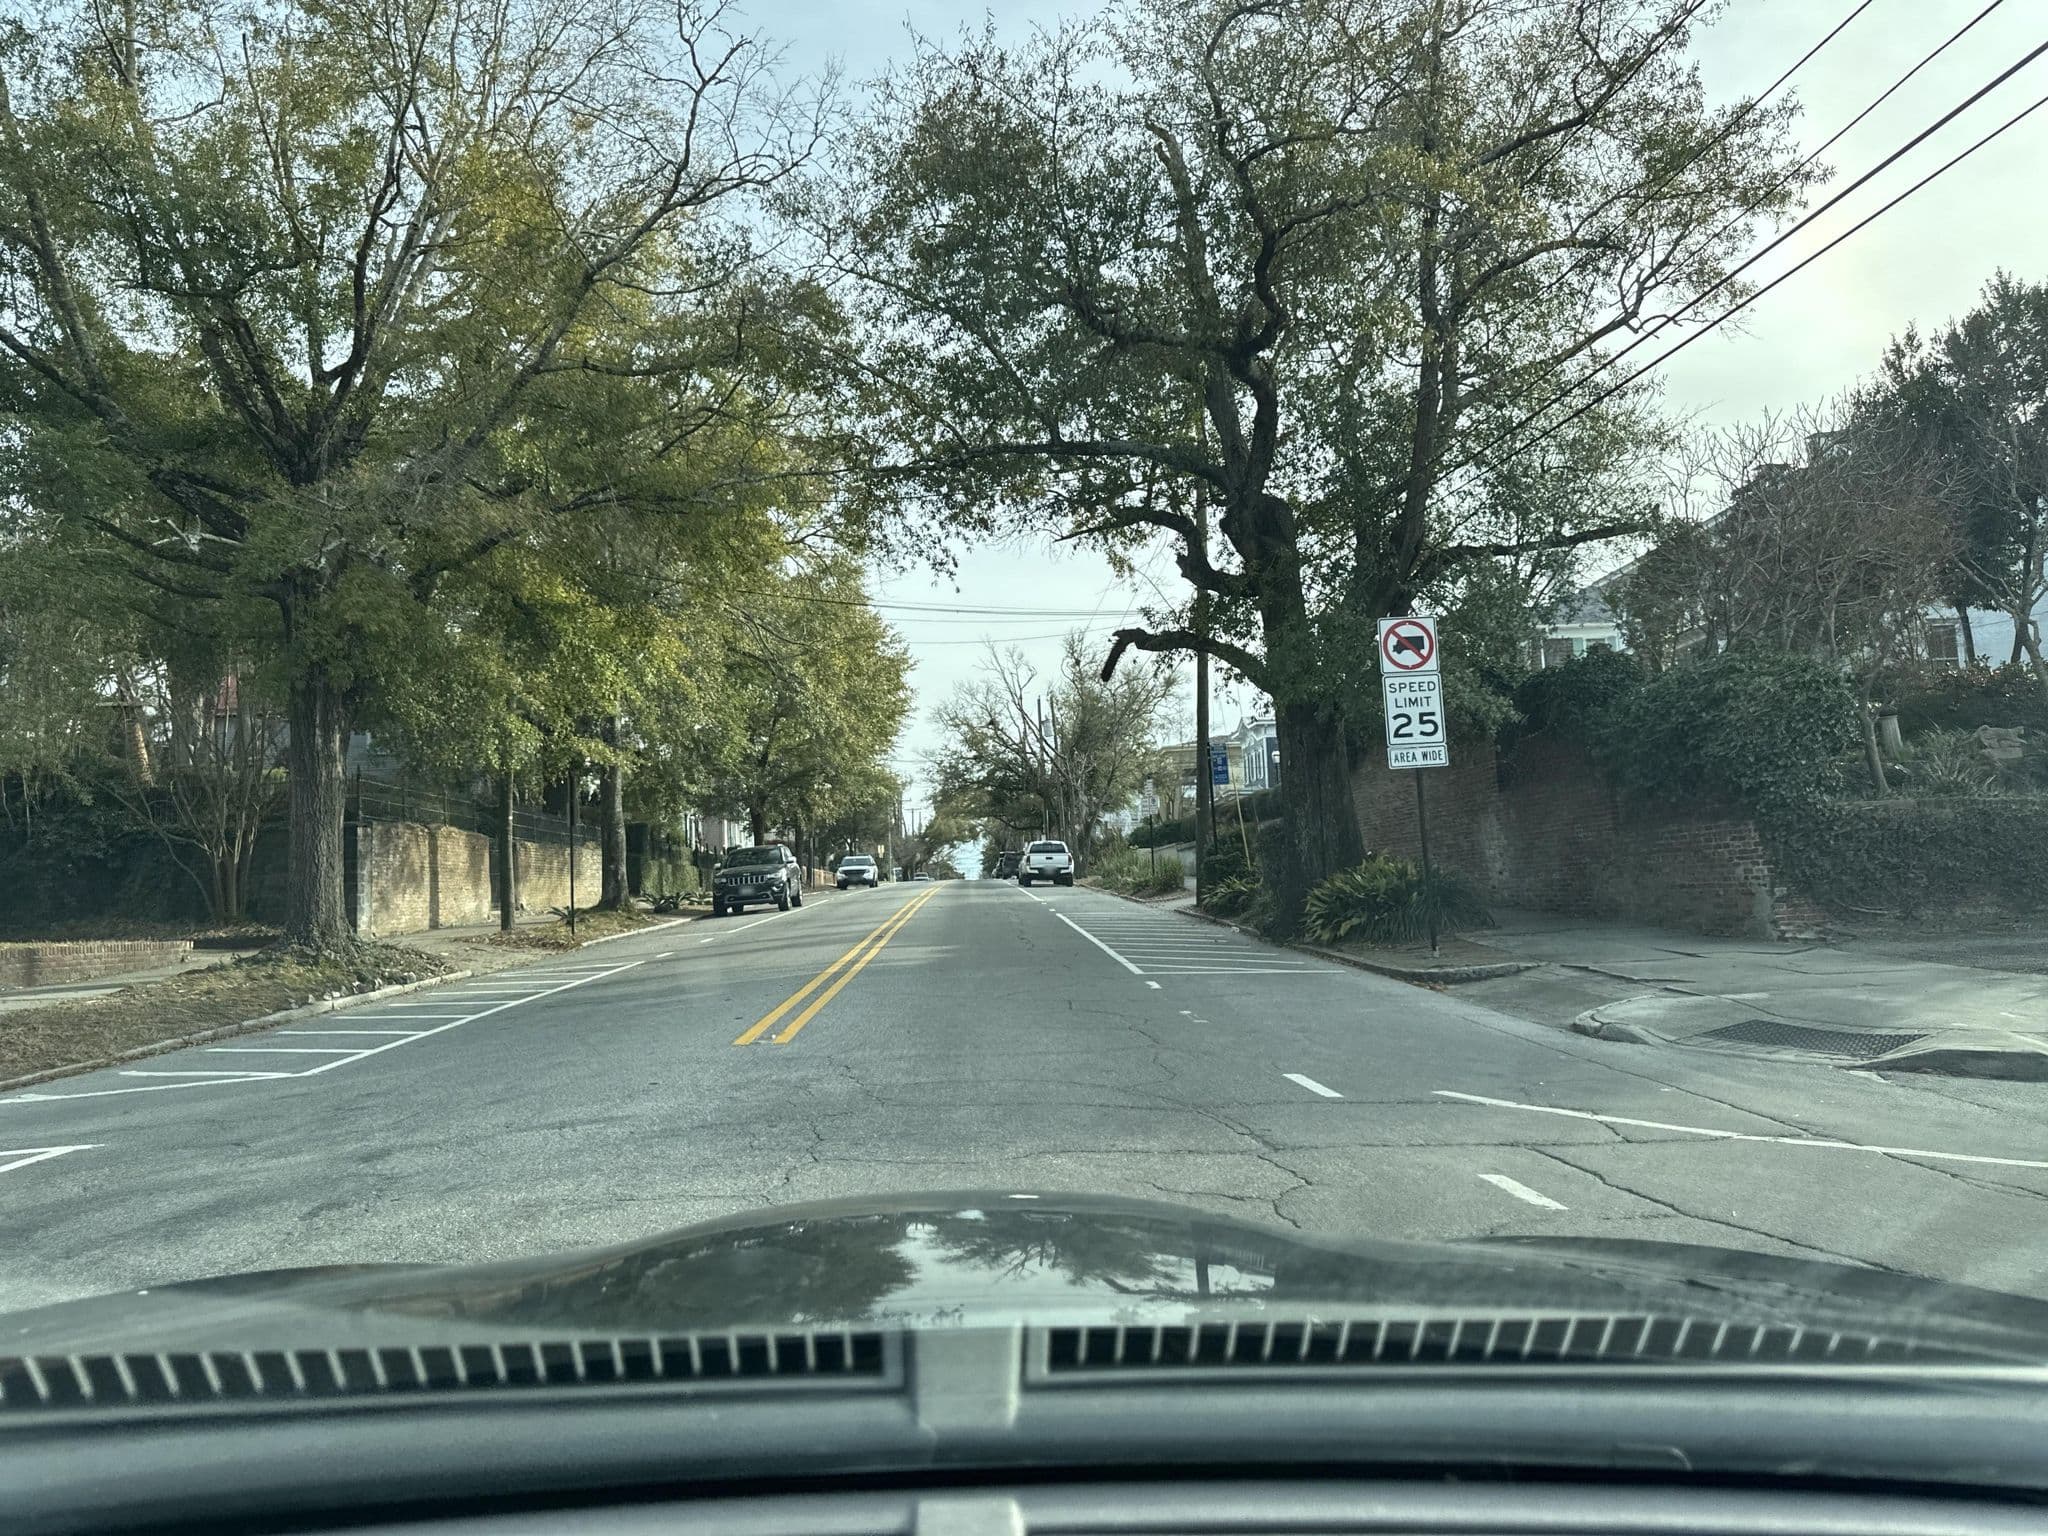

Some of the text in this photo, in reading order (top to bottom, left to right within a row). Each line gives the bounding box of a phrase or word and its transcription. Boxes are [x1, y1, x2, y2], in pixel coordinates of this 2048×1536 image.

[1389, 681, 1436, 693] SPEED
[1395, 696, 1432, 708] LIMIT
[1392, 712, 1439, 738] 25
[1394, 750, 1443, 763] AREA WIDE
